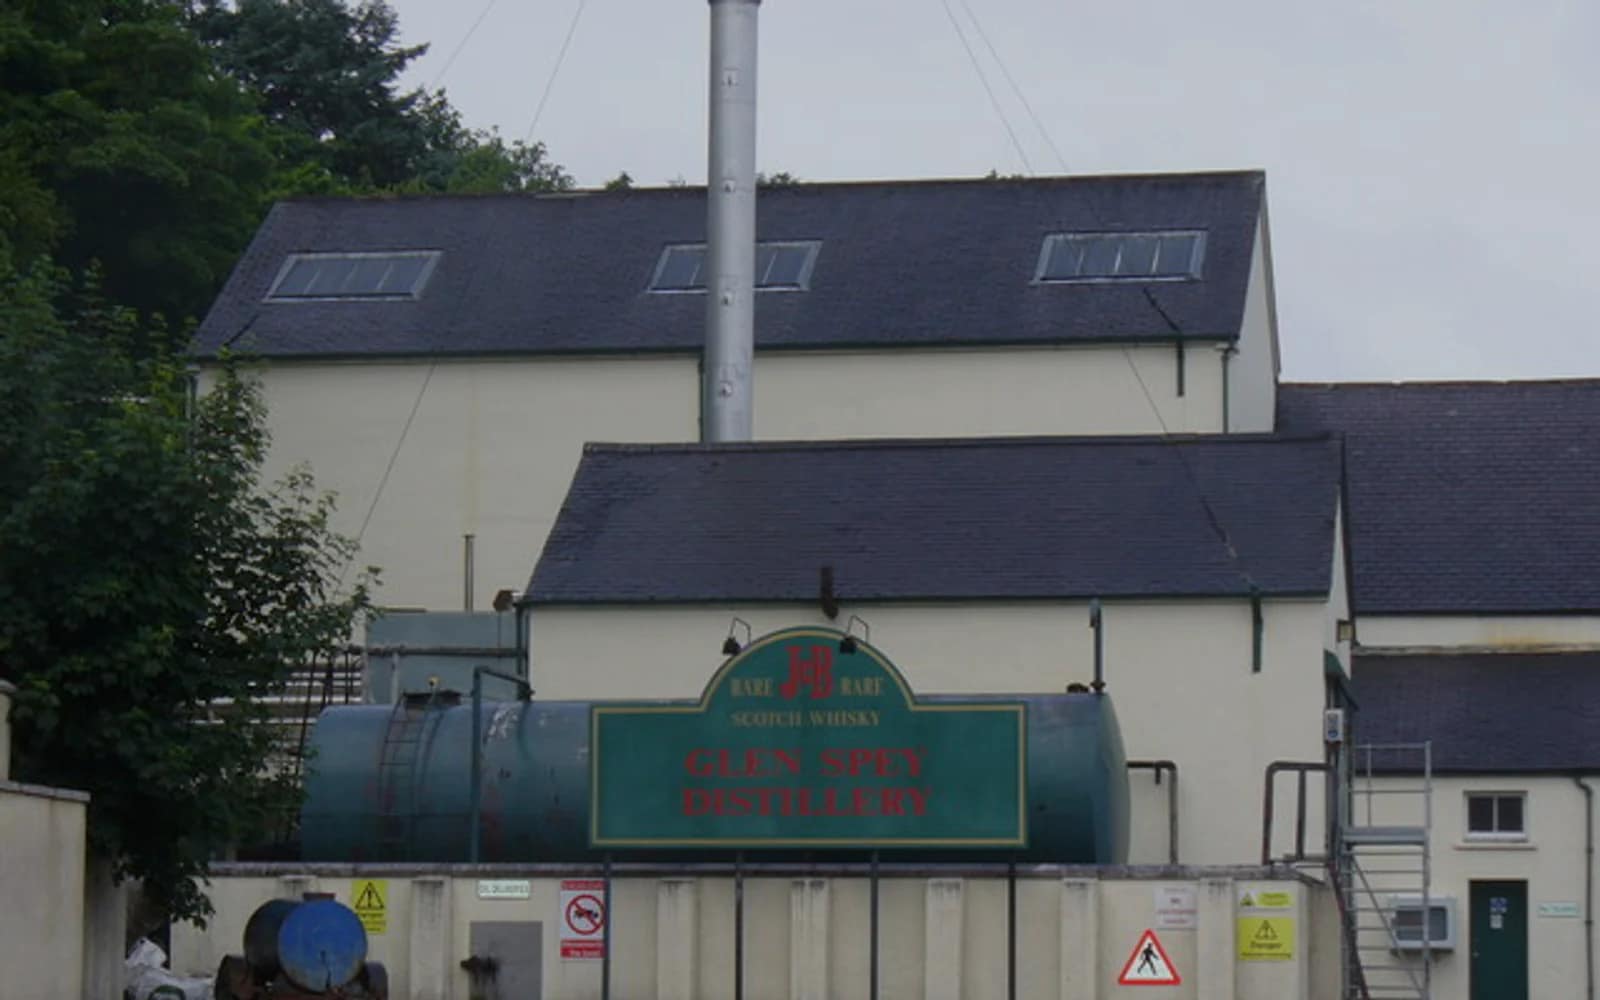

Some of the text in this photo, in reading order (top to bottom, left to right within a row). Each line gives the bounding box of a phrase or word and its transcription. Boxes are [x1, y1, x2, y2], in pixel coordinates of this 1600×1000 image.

[730, 677, 773, 697] RARE
[840, 676, 884, 697] RARE
[730, 709, 881, 727] SCOTCH WHISKY
[684, 747, 928, 778] GLEN SPEY
[682, 787, 931, 817] DISTILLERY
